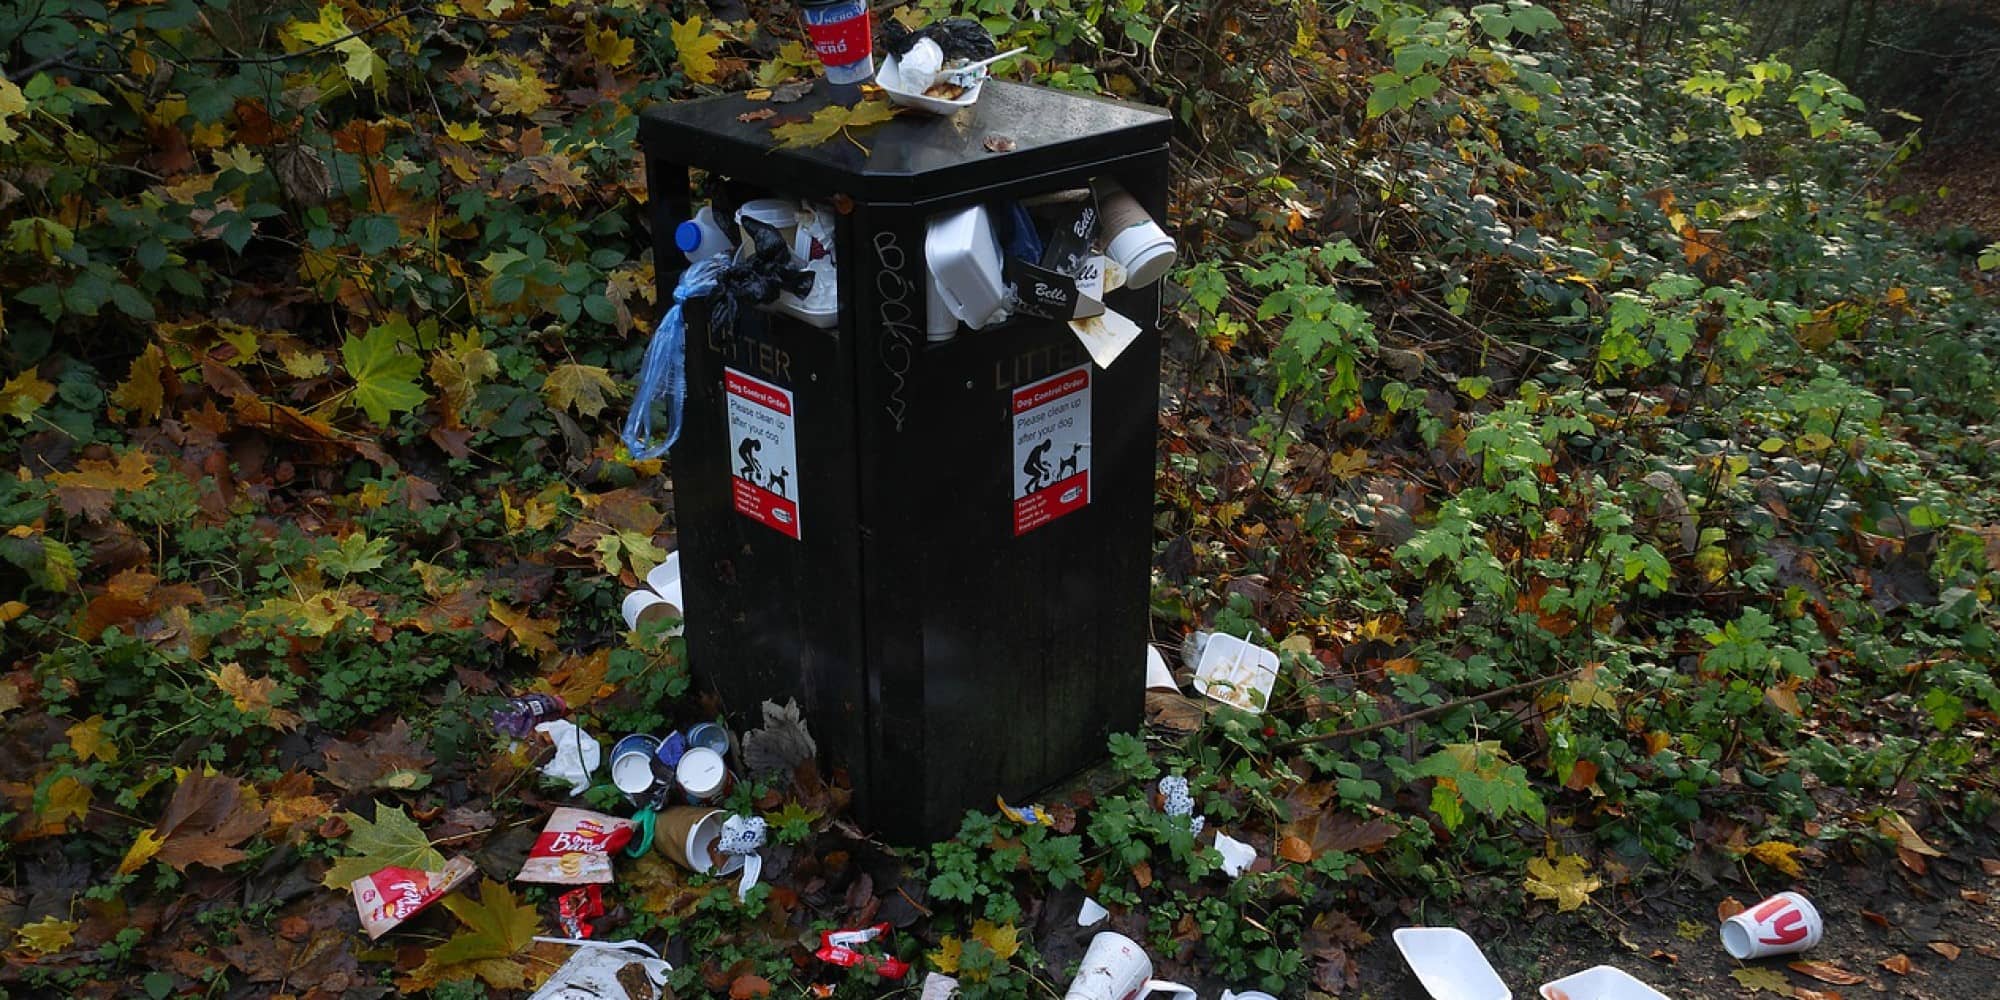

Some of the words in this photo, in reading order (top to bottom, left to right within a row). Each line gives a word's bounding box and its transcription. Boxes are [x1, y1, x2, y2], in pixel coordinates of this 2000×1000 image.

[1034, 282, 1067, 301] Bells
[1017, 411, 1046, 429] Please
[1048, 402, 1069, 417] clean
